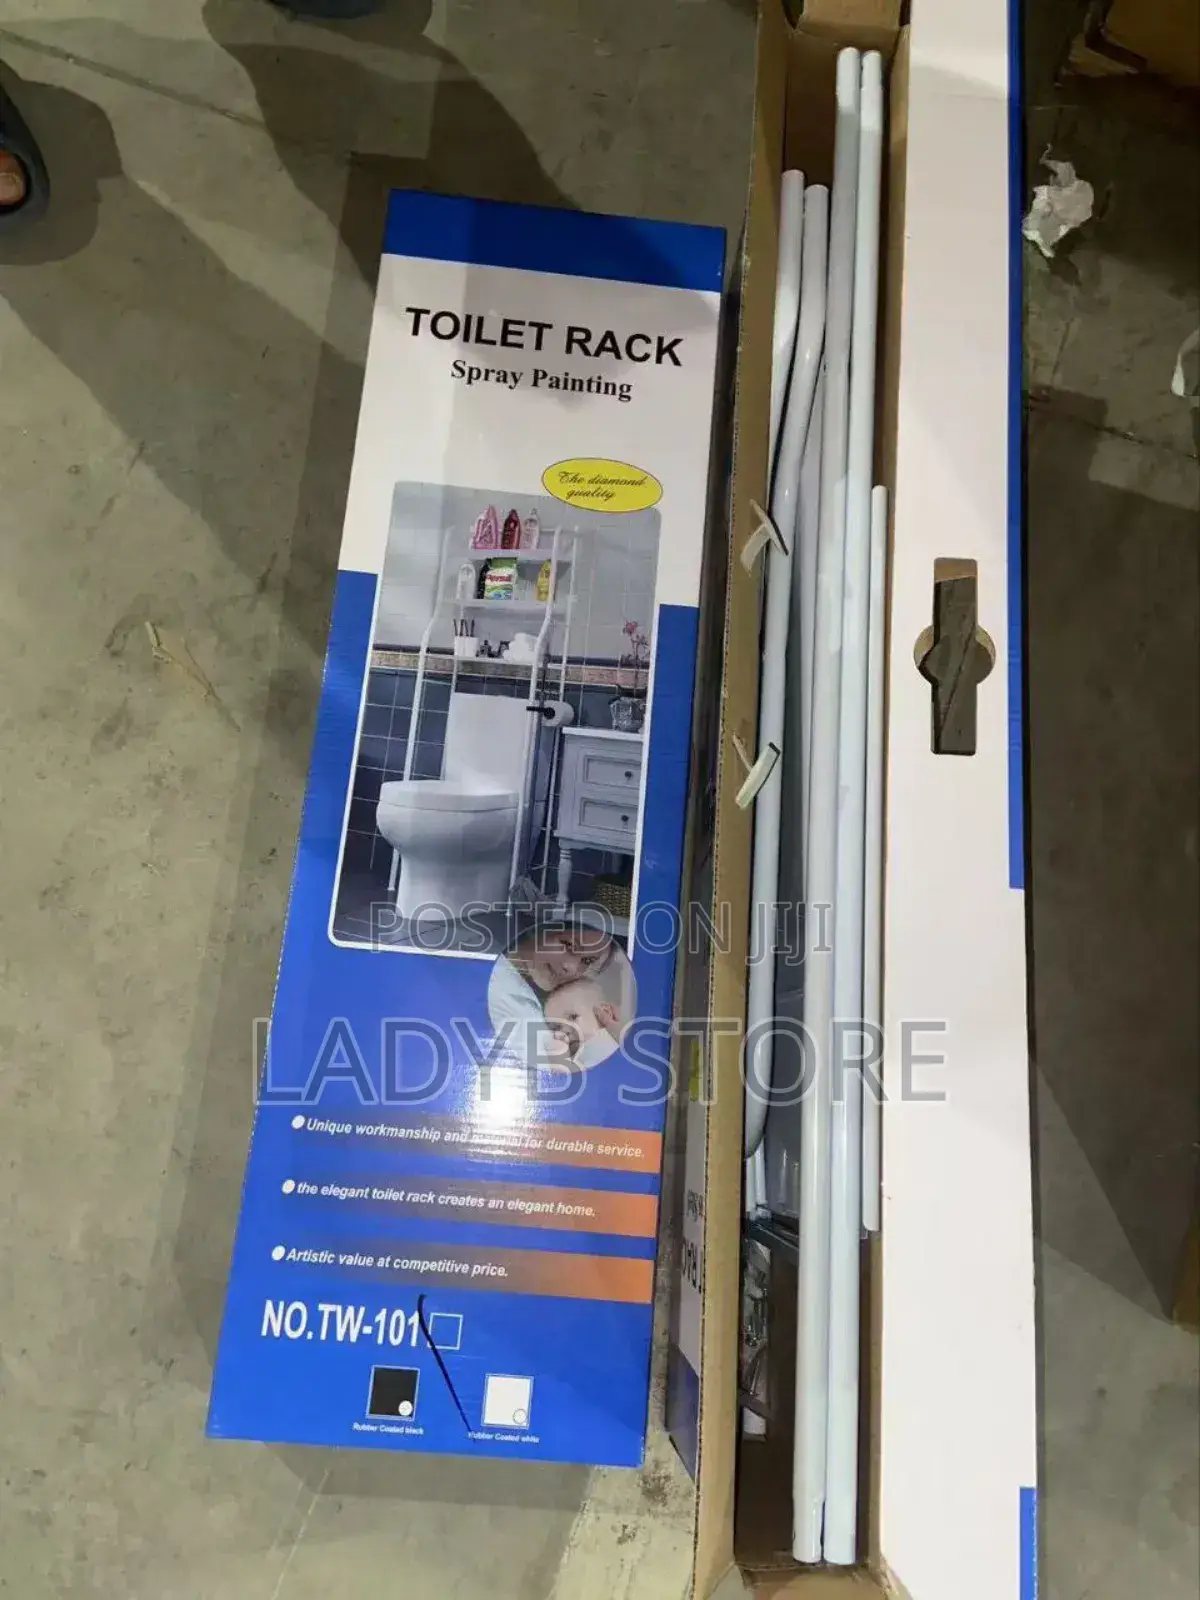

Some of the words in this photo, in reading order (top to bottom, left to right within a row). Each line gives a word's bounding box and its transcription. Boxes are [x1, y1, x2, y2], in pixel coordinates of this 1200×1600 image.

[405, 307, 553, 351] TOILET
[564, 326, 684, 367] RACK
[450, 359, 524, 389] Spray
[531, 368, 634, 402] Painting
[559, 471, 585, 484] The
[587, 474, 648, 487] diamond
[566, 487, 615, 502] quality
[306, 1117, 352, 1135] Unique
[355, 1122, 441, 1142] workmanship
[444, 1131, 469, 1143] and
[545, 1136, 594, 1153] durable
[597, 1142, 645, 1158] service.
[296, 1181, 318, 1195] the
[320, 1184, 370, 1201] elegant
[371, 1187, 404, 1203] toilet
[405, 1189, 435, 1204] rack
[437, 1193, 485, 1208] creates
[487, 1198, 505, 1210] an
[506, 1199, 555, 1216] elegant
[555, 1203, 596, 1218] home.
[286, 1248, 335, 1265] Artistic
[338, 1253, 374, 1268] value
[376, 1256, 391, 1269] at
[392, 1259, 470, 1276] competitive
[471, 1263, 509, 1279] price.
[260, 1299, 421, 1347] NO.TW-101
[353, 1422, 378, 1432] Rubber
[379, 1424, 405, 1435] Coated
[494, 1433, 520, 1443] Coated
